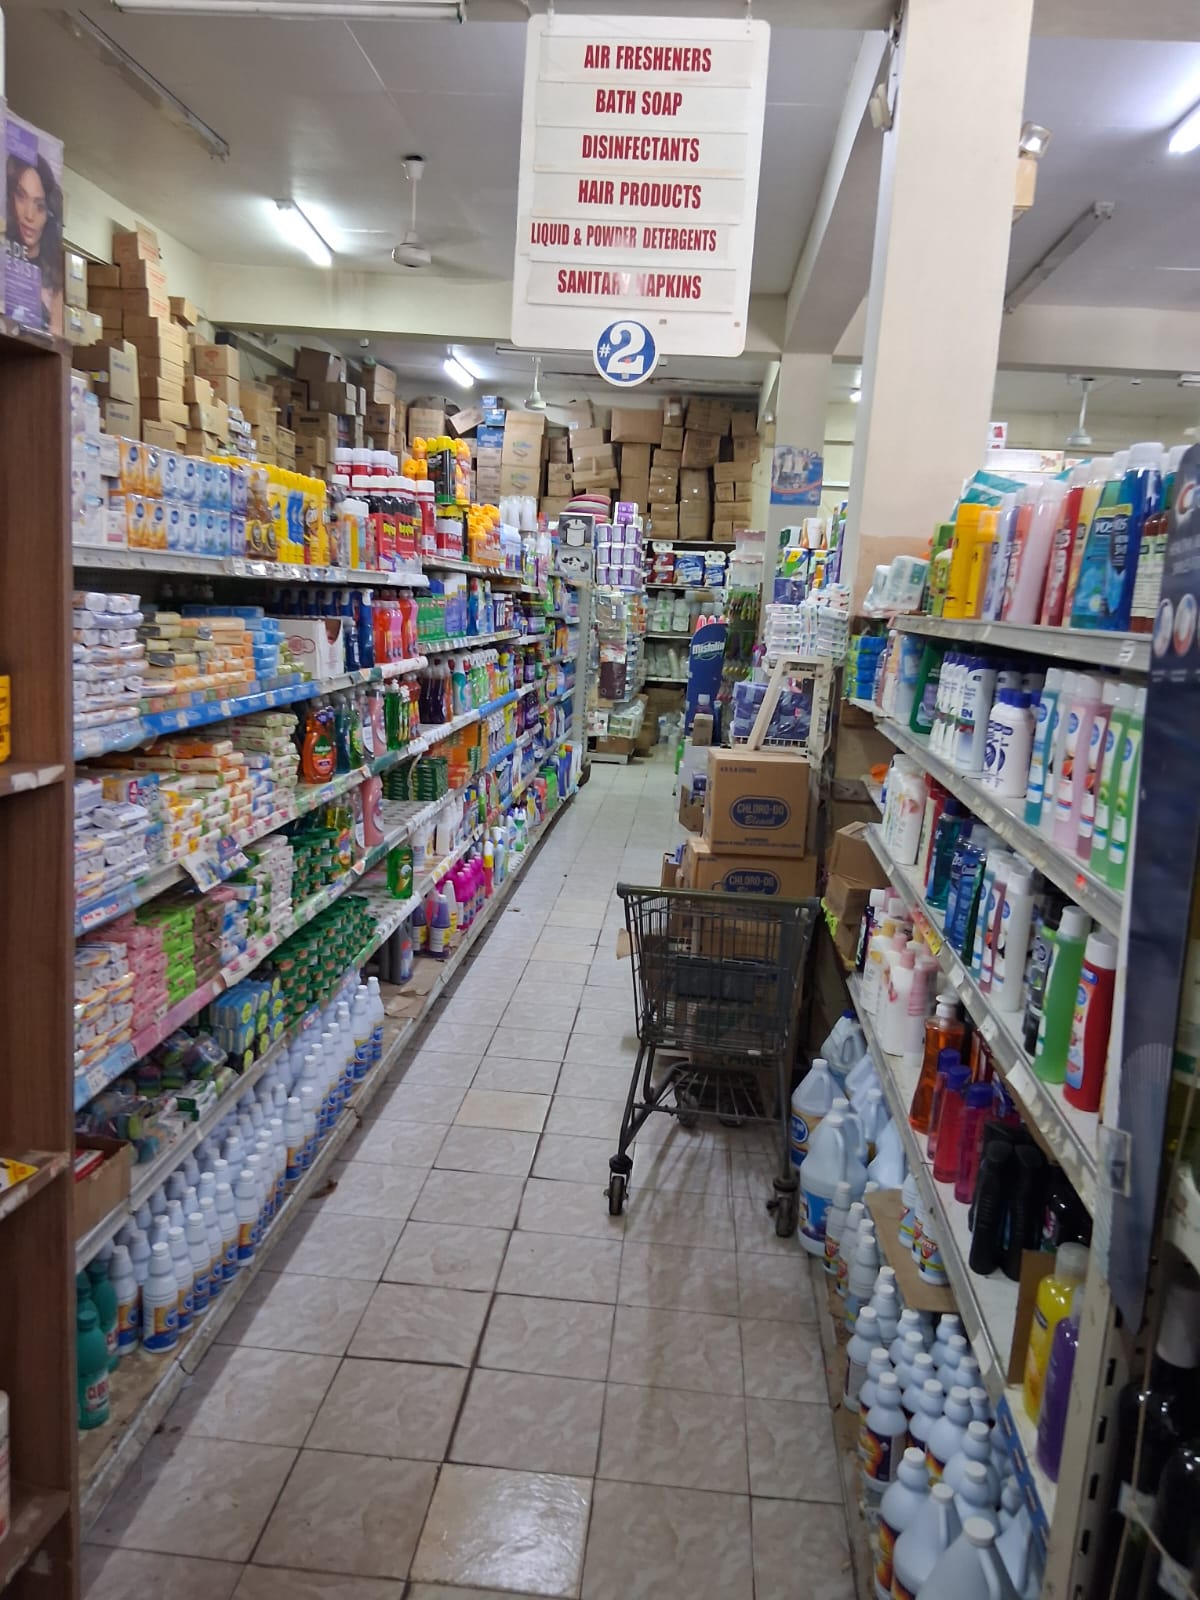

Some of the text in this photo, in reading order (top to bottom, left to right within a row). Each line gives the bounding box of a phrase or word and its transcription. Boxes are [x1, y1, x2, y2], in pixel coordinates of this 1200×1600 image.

[584, 45, 712, 73] AIR FRESHENERS
[595, 89, 683, 117] BATH SOAP
[582, 135, 700, 162] DISINFECTANTS
[578, 180, 701, 209] HAIR PRODUCTS
[531, 222, 717, 252] LIQUID & POWDER DETERGENTS
[636, 273, 702, 300] NAPKINS
[599, 322, 647, 374] #2
